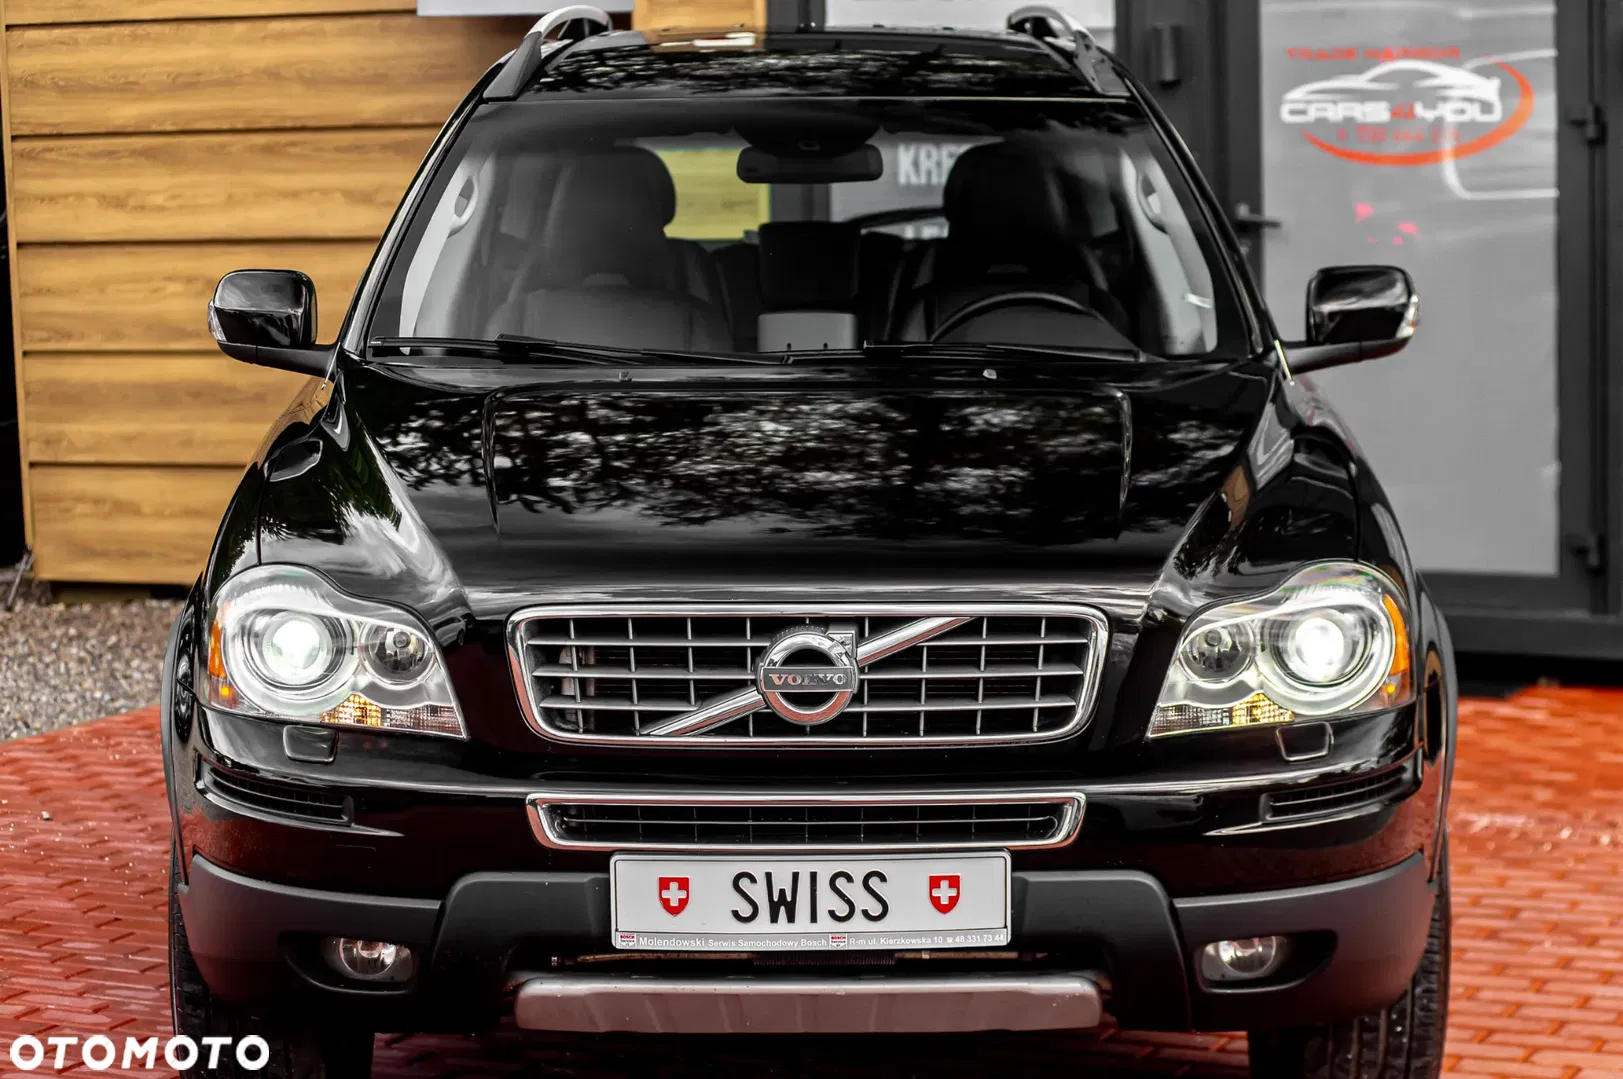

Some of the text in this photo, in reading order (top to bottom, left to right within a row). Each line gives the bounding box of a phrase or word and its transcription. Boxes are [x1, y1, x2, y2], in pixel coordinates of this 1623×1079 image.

[769, 673, 847, 686] VOLVO
[731, 871, 889, 924] SWISS
[639, 937, 827, 948] Molendowski Serwis Samochodowy Bosch
[868, 937, 879, 945] ul.
[880, 936, 931, 945] Kierzkowska
[934, 936, 942, 944] 10
[967, 935, 980, 943] 331
[983, 934, 992, 942] 73
[994, 934, 1004, 942] 44
